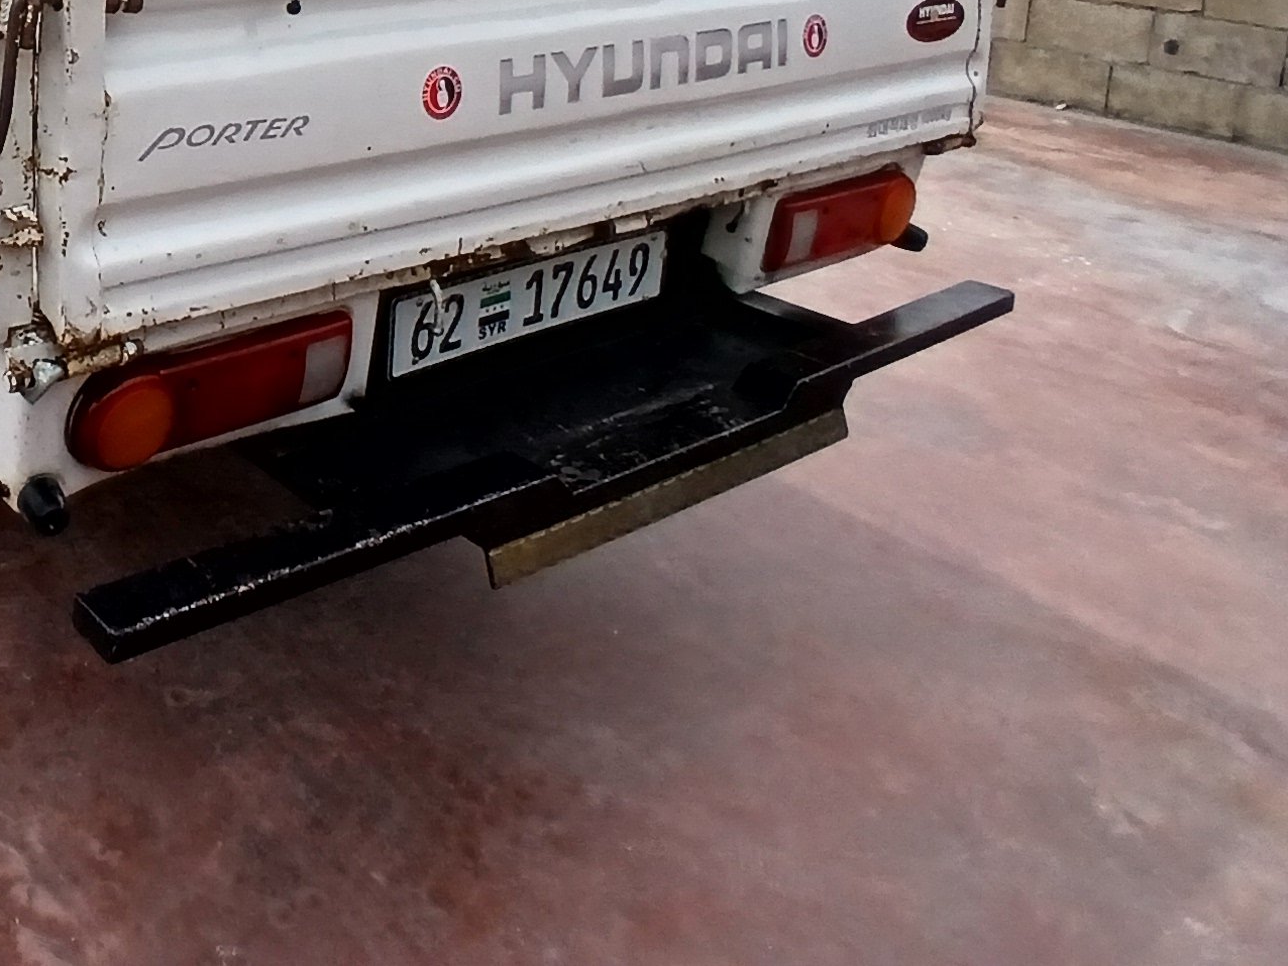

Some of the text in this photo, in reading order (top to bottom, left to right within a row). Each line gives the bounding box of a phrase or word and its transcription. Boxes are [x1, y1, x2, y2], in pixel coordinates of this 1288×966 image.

[498, 18, 788, 116] HYUNDAI
[137, 114, 310, 163] PORTER
[410, 242, 651, 362] 62 17649
[478, 320, 507, 340] SYR
